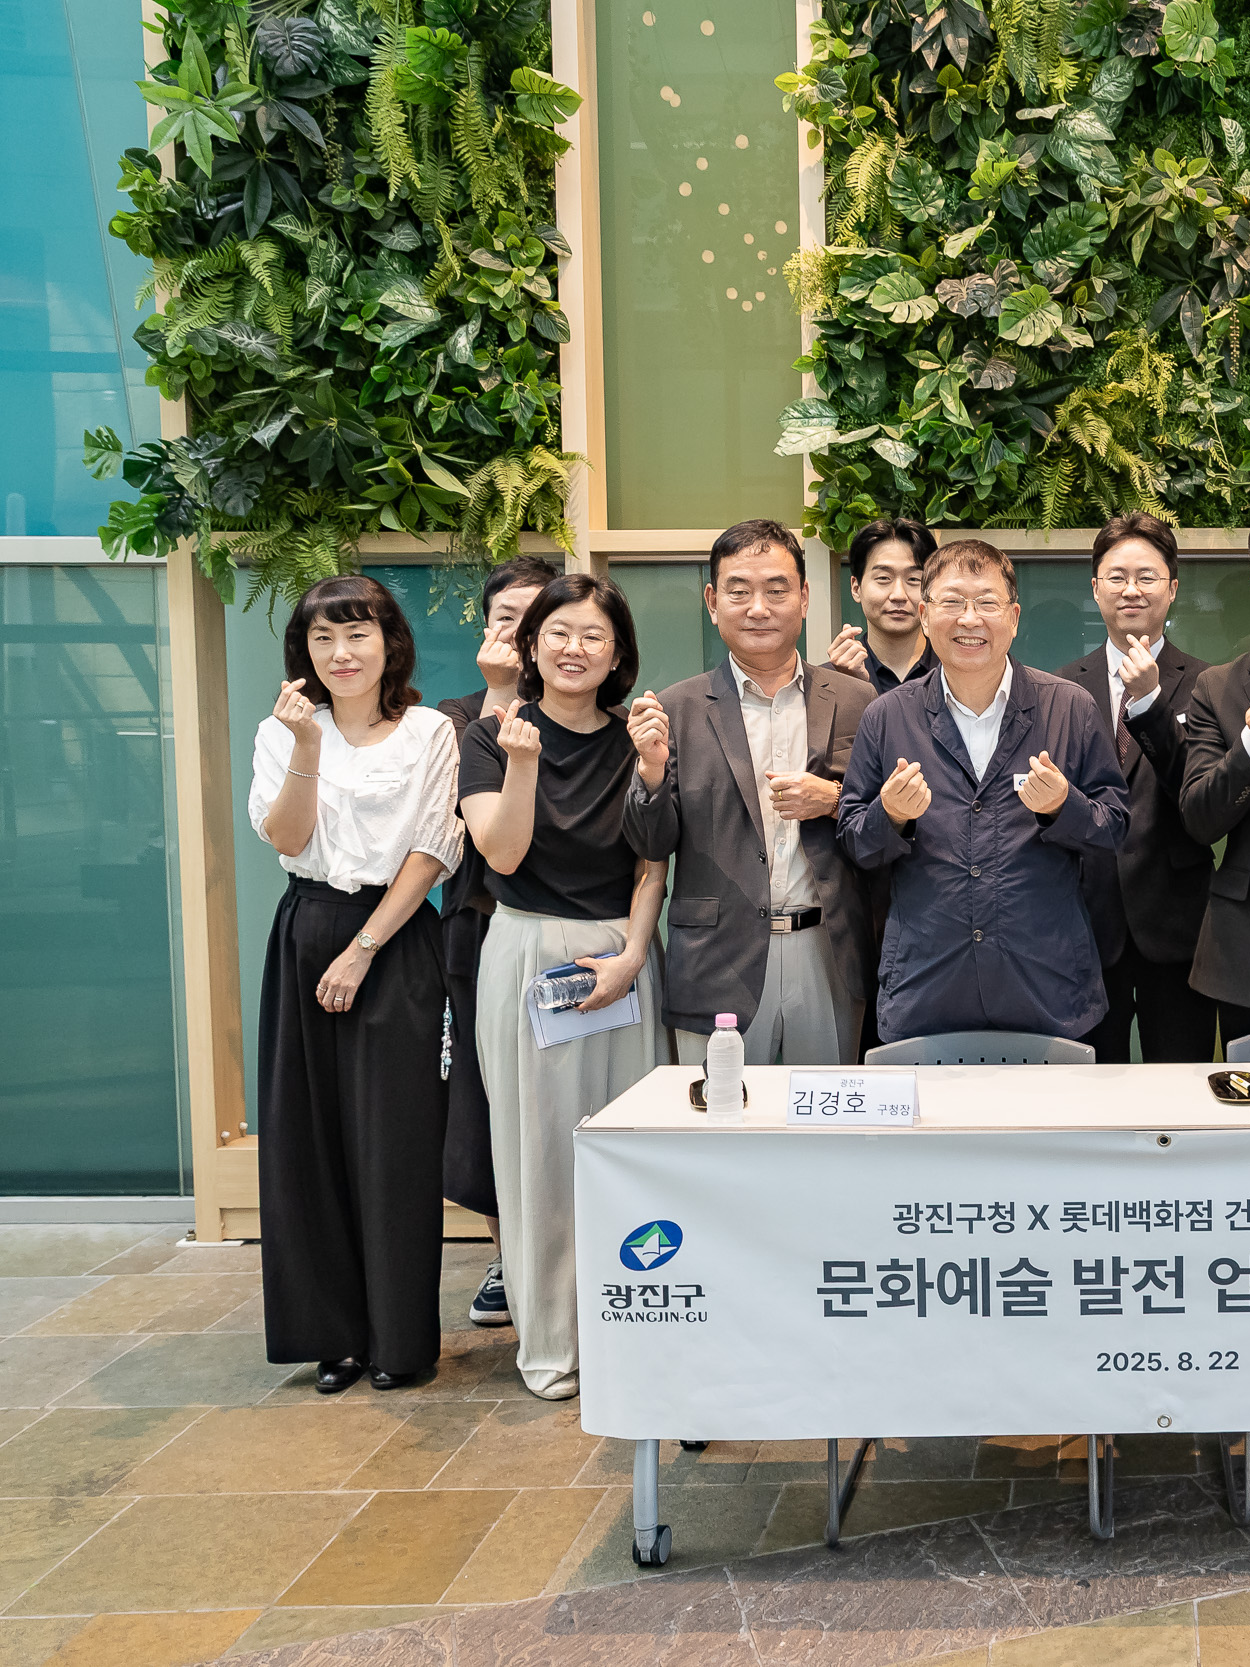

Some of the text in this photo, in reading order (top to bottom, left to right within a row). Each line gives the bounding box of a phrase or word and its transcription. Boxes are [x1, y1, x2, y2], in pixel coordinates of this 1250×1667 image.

[840, 1078, 865, 1088] 광진구
[793, 1090, 911, 1117] 김경호 구청장
[893, 1201, 1016, 1235] 광진구청
[1027, 1204, 1051, 1231] X
[1060, 1199, 1213, 1234] 롯데백화점
[601, 1283, 706, 1309] 광진구
[816, 1256, 1053, 1318] 문화예술
[1073, 1255, 1186, 1316] 발전
[601, 1310, 708, 1323] GWANGJIN-GU
[1096, 1351, 1240, 1372] 2025. 8. 22
